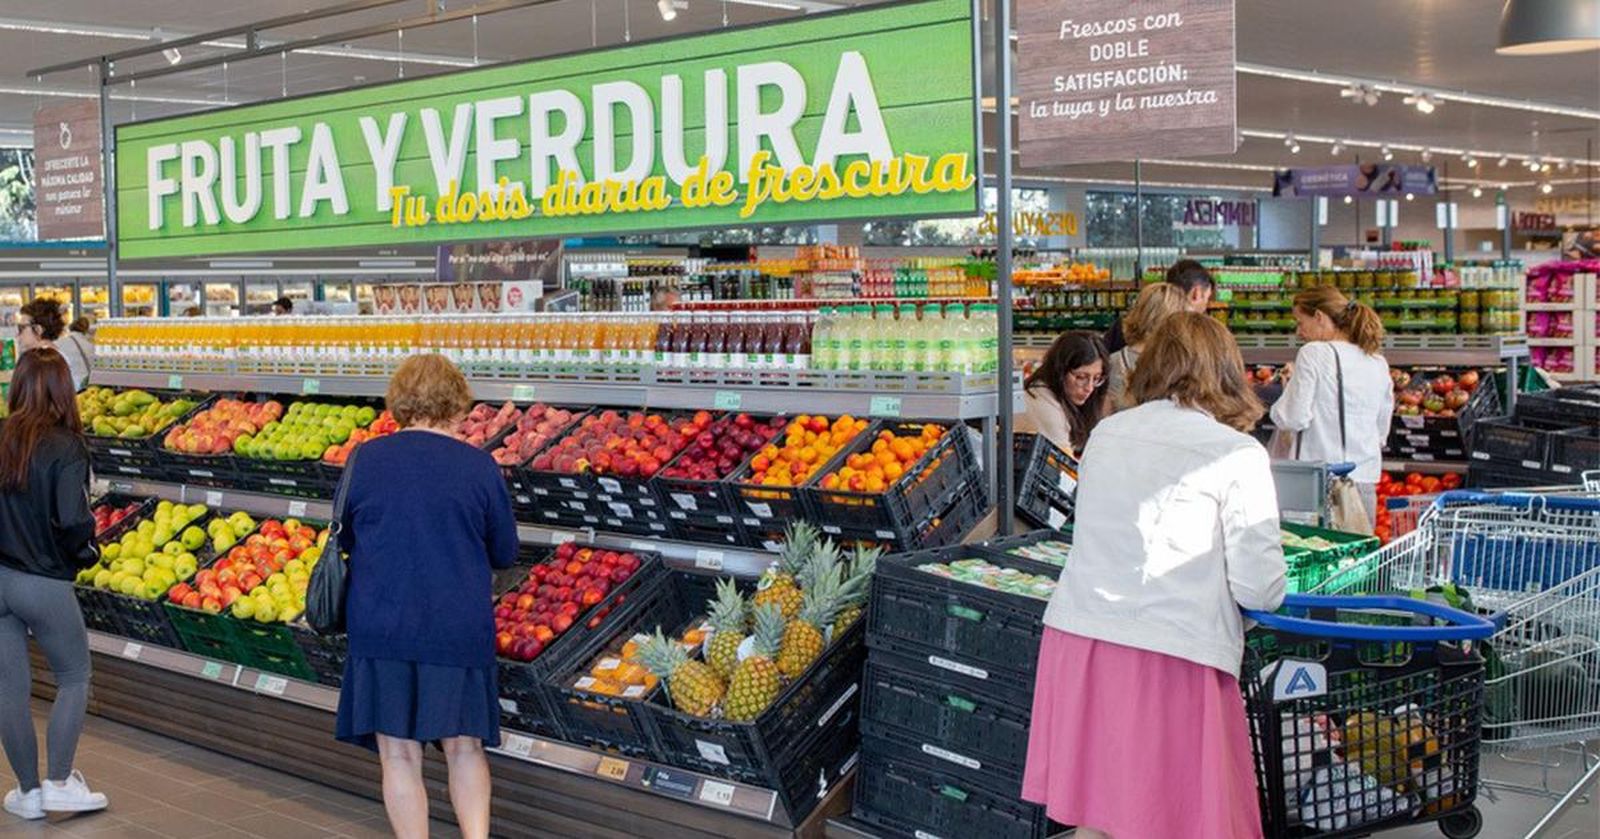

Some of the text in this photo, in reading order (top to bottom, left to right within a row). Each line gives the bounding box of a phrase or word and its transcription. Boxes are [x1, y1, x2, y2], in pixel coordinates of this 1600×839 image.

[1059, 11, 1183, 39] Frescos con
[1089, 39, 1149, 62] DOBLE
[1054, 60, 1188, 92] SATISFACCIÓN:
[1030, 88, 1218, 120] la tuya y la nuestra
[147, 51, 896, 230] FRUTA Y VERDURA
[66, 171, 94, 185] CALIDAD
[389, 150, 976, 228] Tu dosis diaria de frescura
